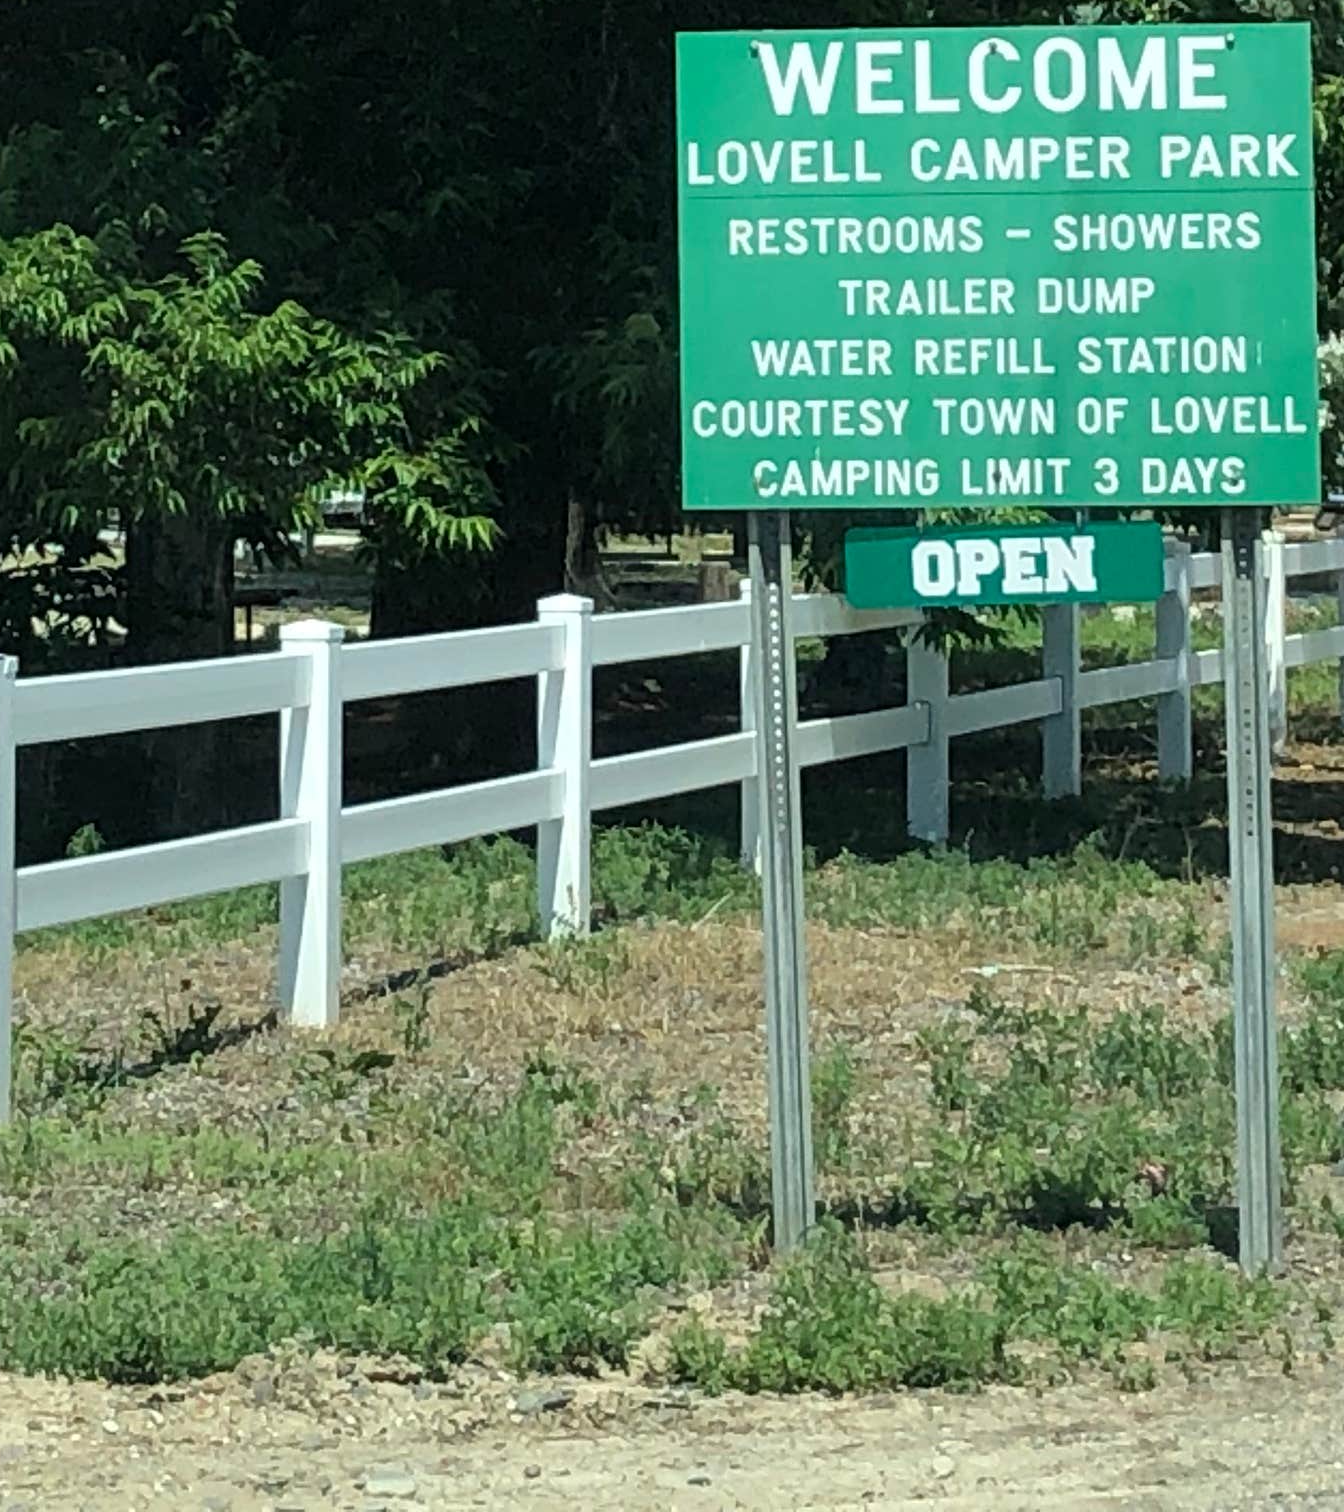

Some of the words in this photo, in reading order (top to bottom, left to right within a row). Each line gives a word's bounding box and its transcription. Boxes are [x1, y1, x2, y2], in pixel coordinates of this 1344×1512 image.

[759, 36, 1227, 115] WELCOME
[688, 140, 881, 184] LOVELL
[911, 137, 1129, 181] CAMPER
[1161, 135, 1298, 177] PARK
[730, 216, 983, 255] RESTROOMS
[1055, 212, 1260, 251] SHOWERS
[839, 279, 1014, 315] TRAILER
[1039, 278, 1154, 313] DUMP
[752, 339, 891, 376] WATER
[916, 338, 1054, 375] REFILL
[1079, 336, 1246, 373] STATION
[693, 399, 908, 437] COURTESY
[933, 399, 1054, 435] TOWN
[1078, 398, 1128, 434] OF
[1152, 397, 1306, 434] LOVELL
[755, 459, 938, 497] CAMPING
[962, 459, 1070, 495] LIMIT
[1095, 458, 1118, 494] 3
[1142, 457, 1245, 493] DAYS
[912, 536, 1096, 596] OPEN
